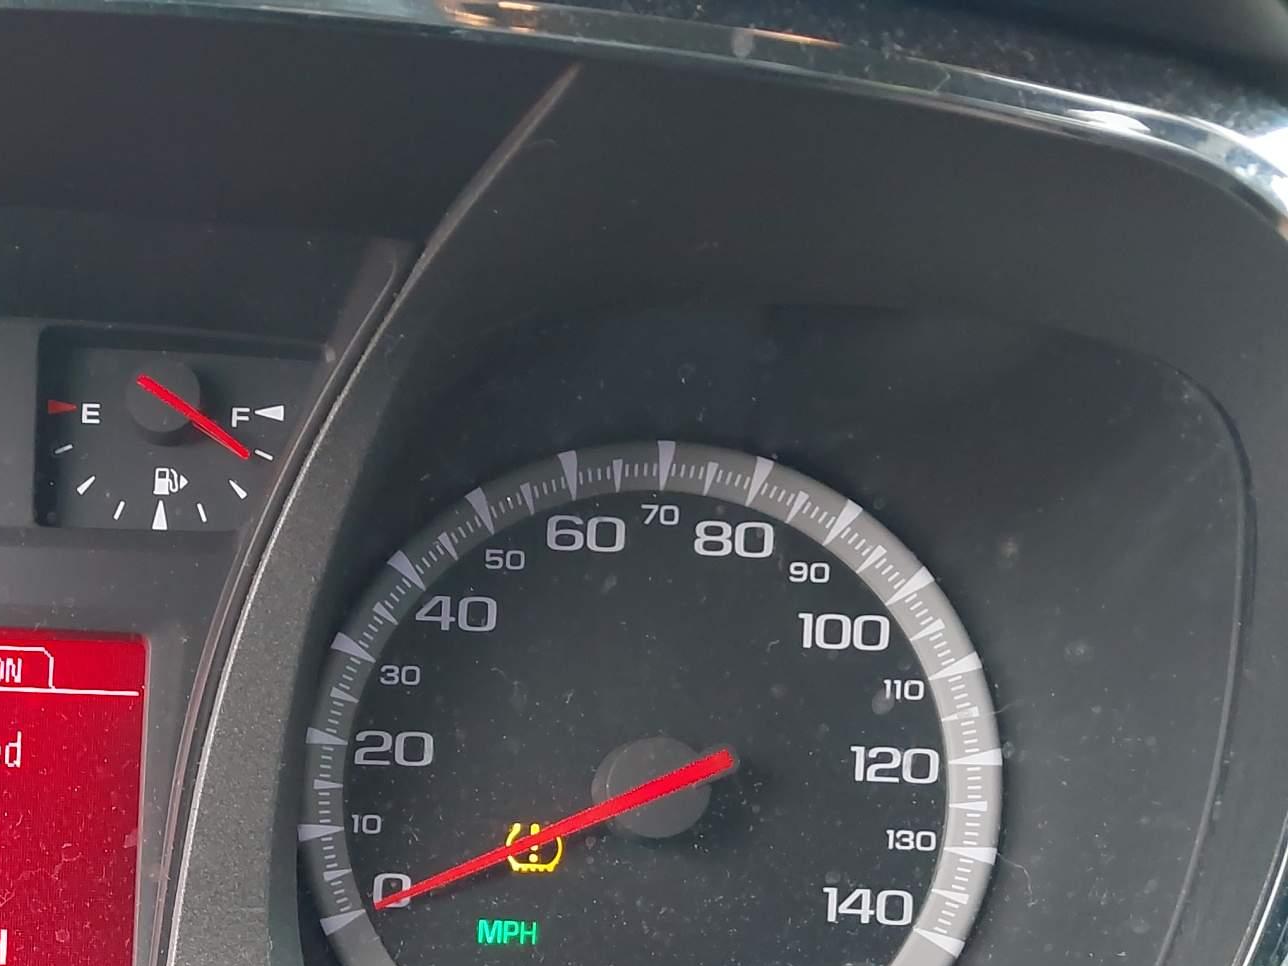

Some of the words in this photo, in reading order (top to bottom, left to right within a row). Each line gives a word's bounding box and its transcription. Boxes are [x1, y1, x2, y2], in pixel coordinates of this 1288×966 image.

[81, 403, 100, 425] E
[231, 407, 250, 428] F
[642, 503, 680, 525] 70
[546, 515, 627, 552] 60
[693, 521, 774, 558] 80
[484, 548, 526, 571] 50
[789, 562, 830, 584] 90
[415, 595, 498, 632] 40
[798, 613, 890, 651] 100
[380, 664, 421, 686] 30
[883, 679, 925, 701] 110
[353, 730, 434, 767] 20
[850, 746, 940, 784] 120
[352, 814, 382, 834] 10
[886, 829, 936, 851] 130
[373, 873, 412, 908] 0
[822, 887, 913, 925] 140
[477, 919, 537, 946] MPH
